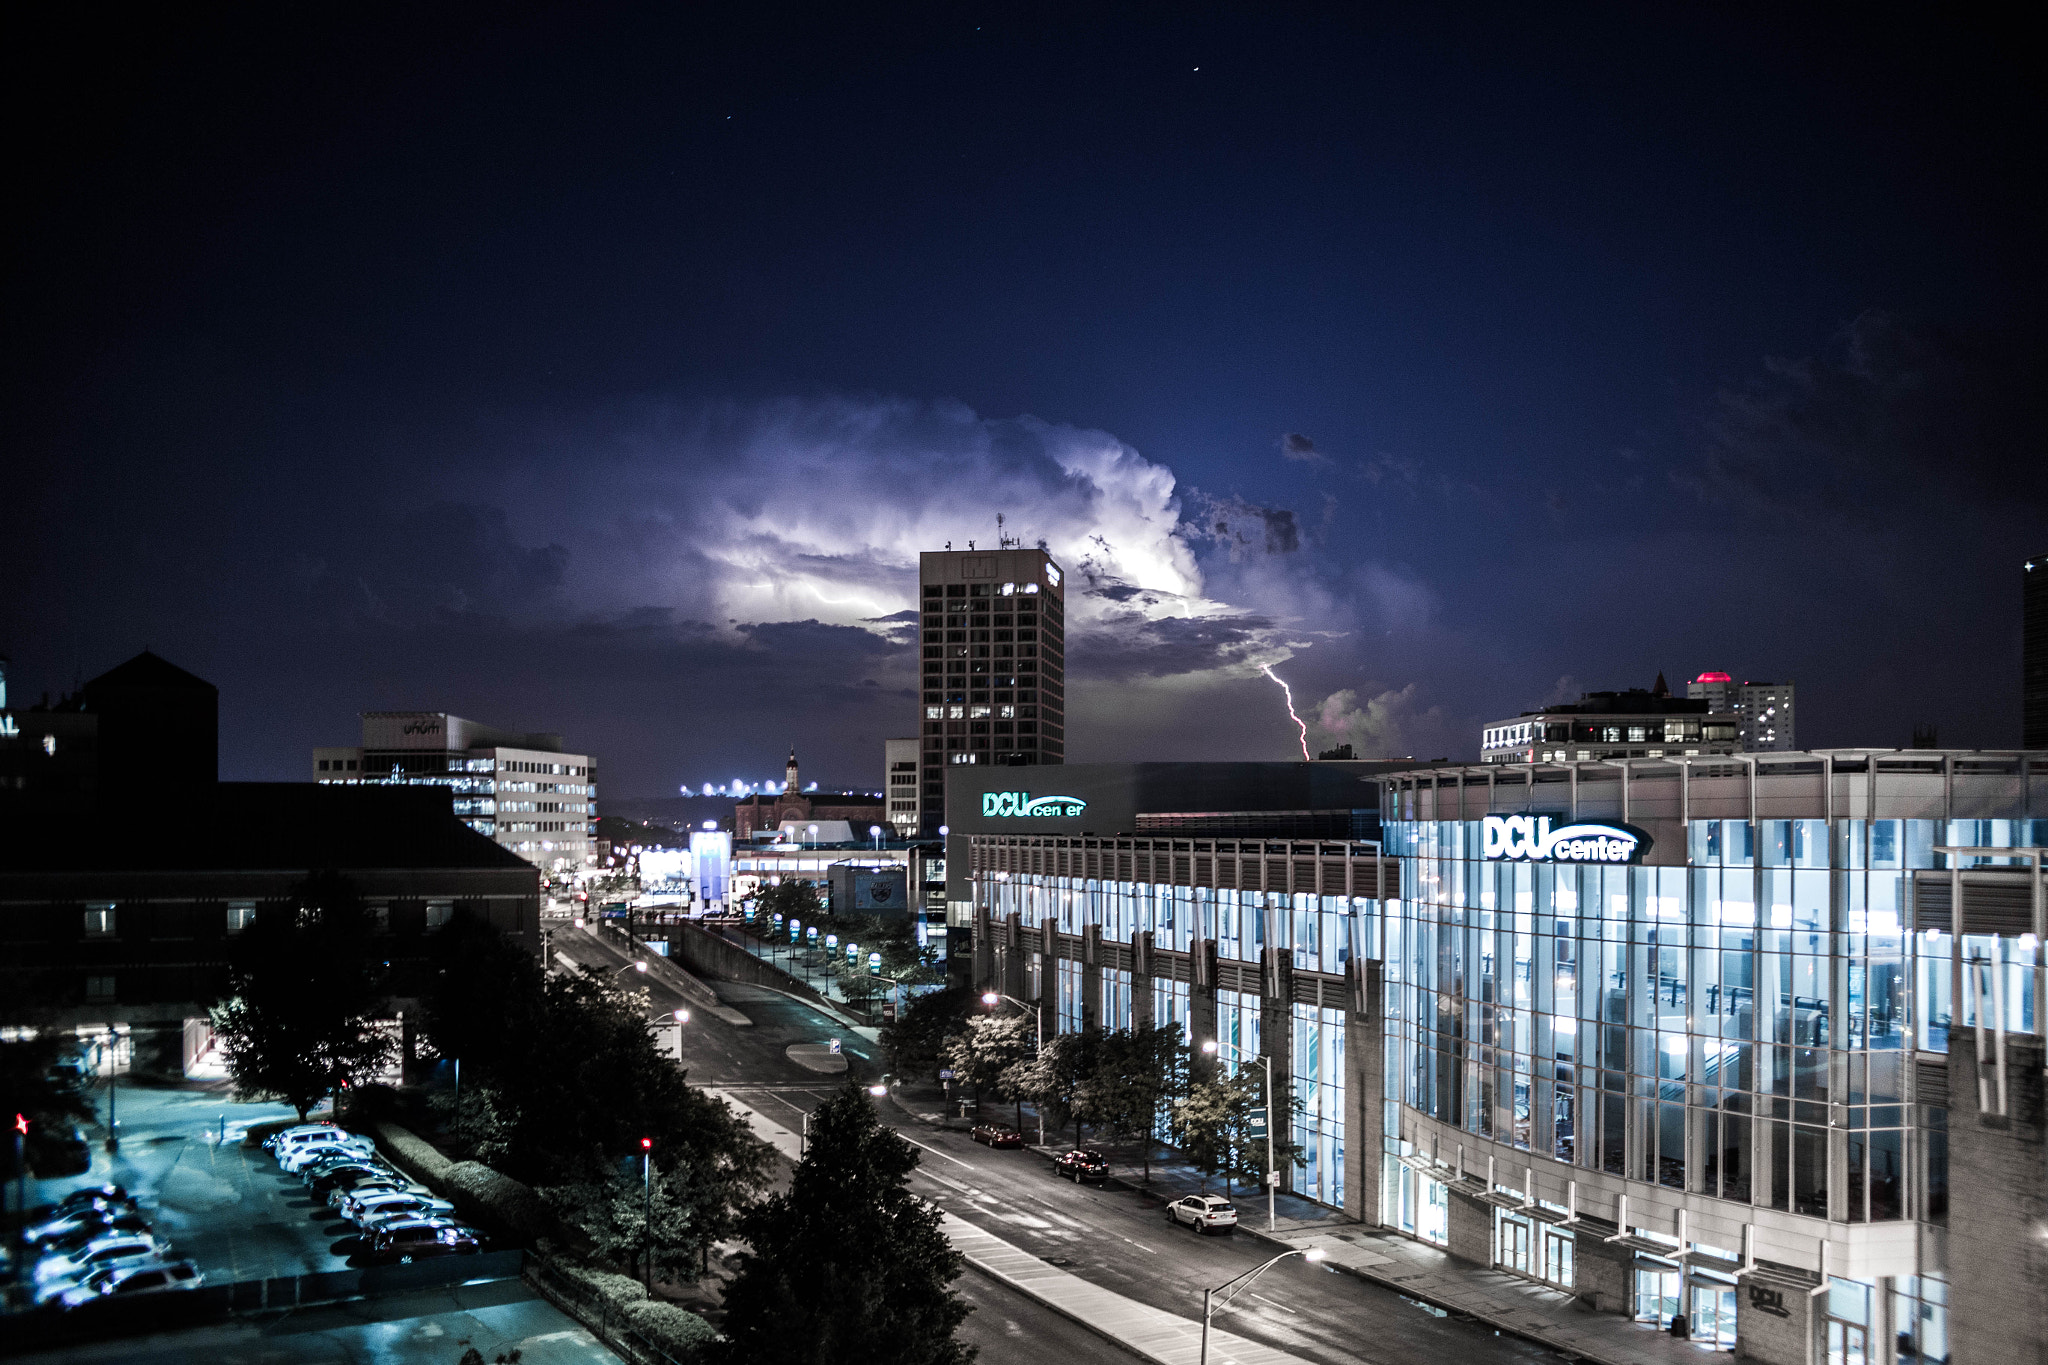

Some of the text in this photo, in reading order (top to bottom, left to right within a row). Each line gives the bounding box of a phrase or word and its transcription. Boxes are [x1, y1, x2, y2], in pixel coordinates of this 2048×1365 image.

[982, 791, 1030, 817] DCU
[1483, 815, 1635, 861] DCU center
[1749, 1284, 1783, 1308] DCU
